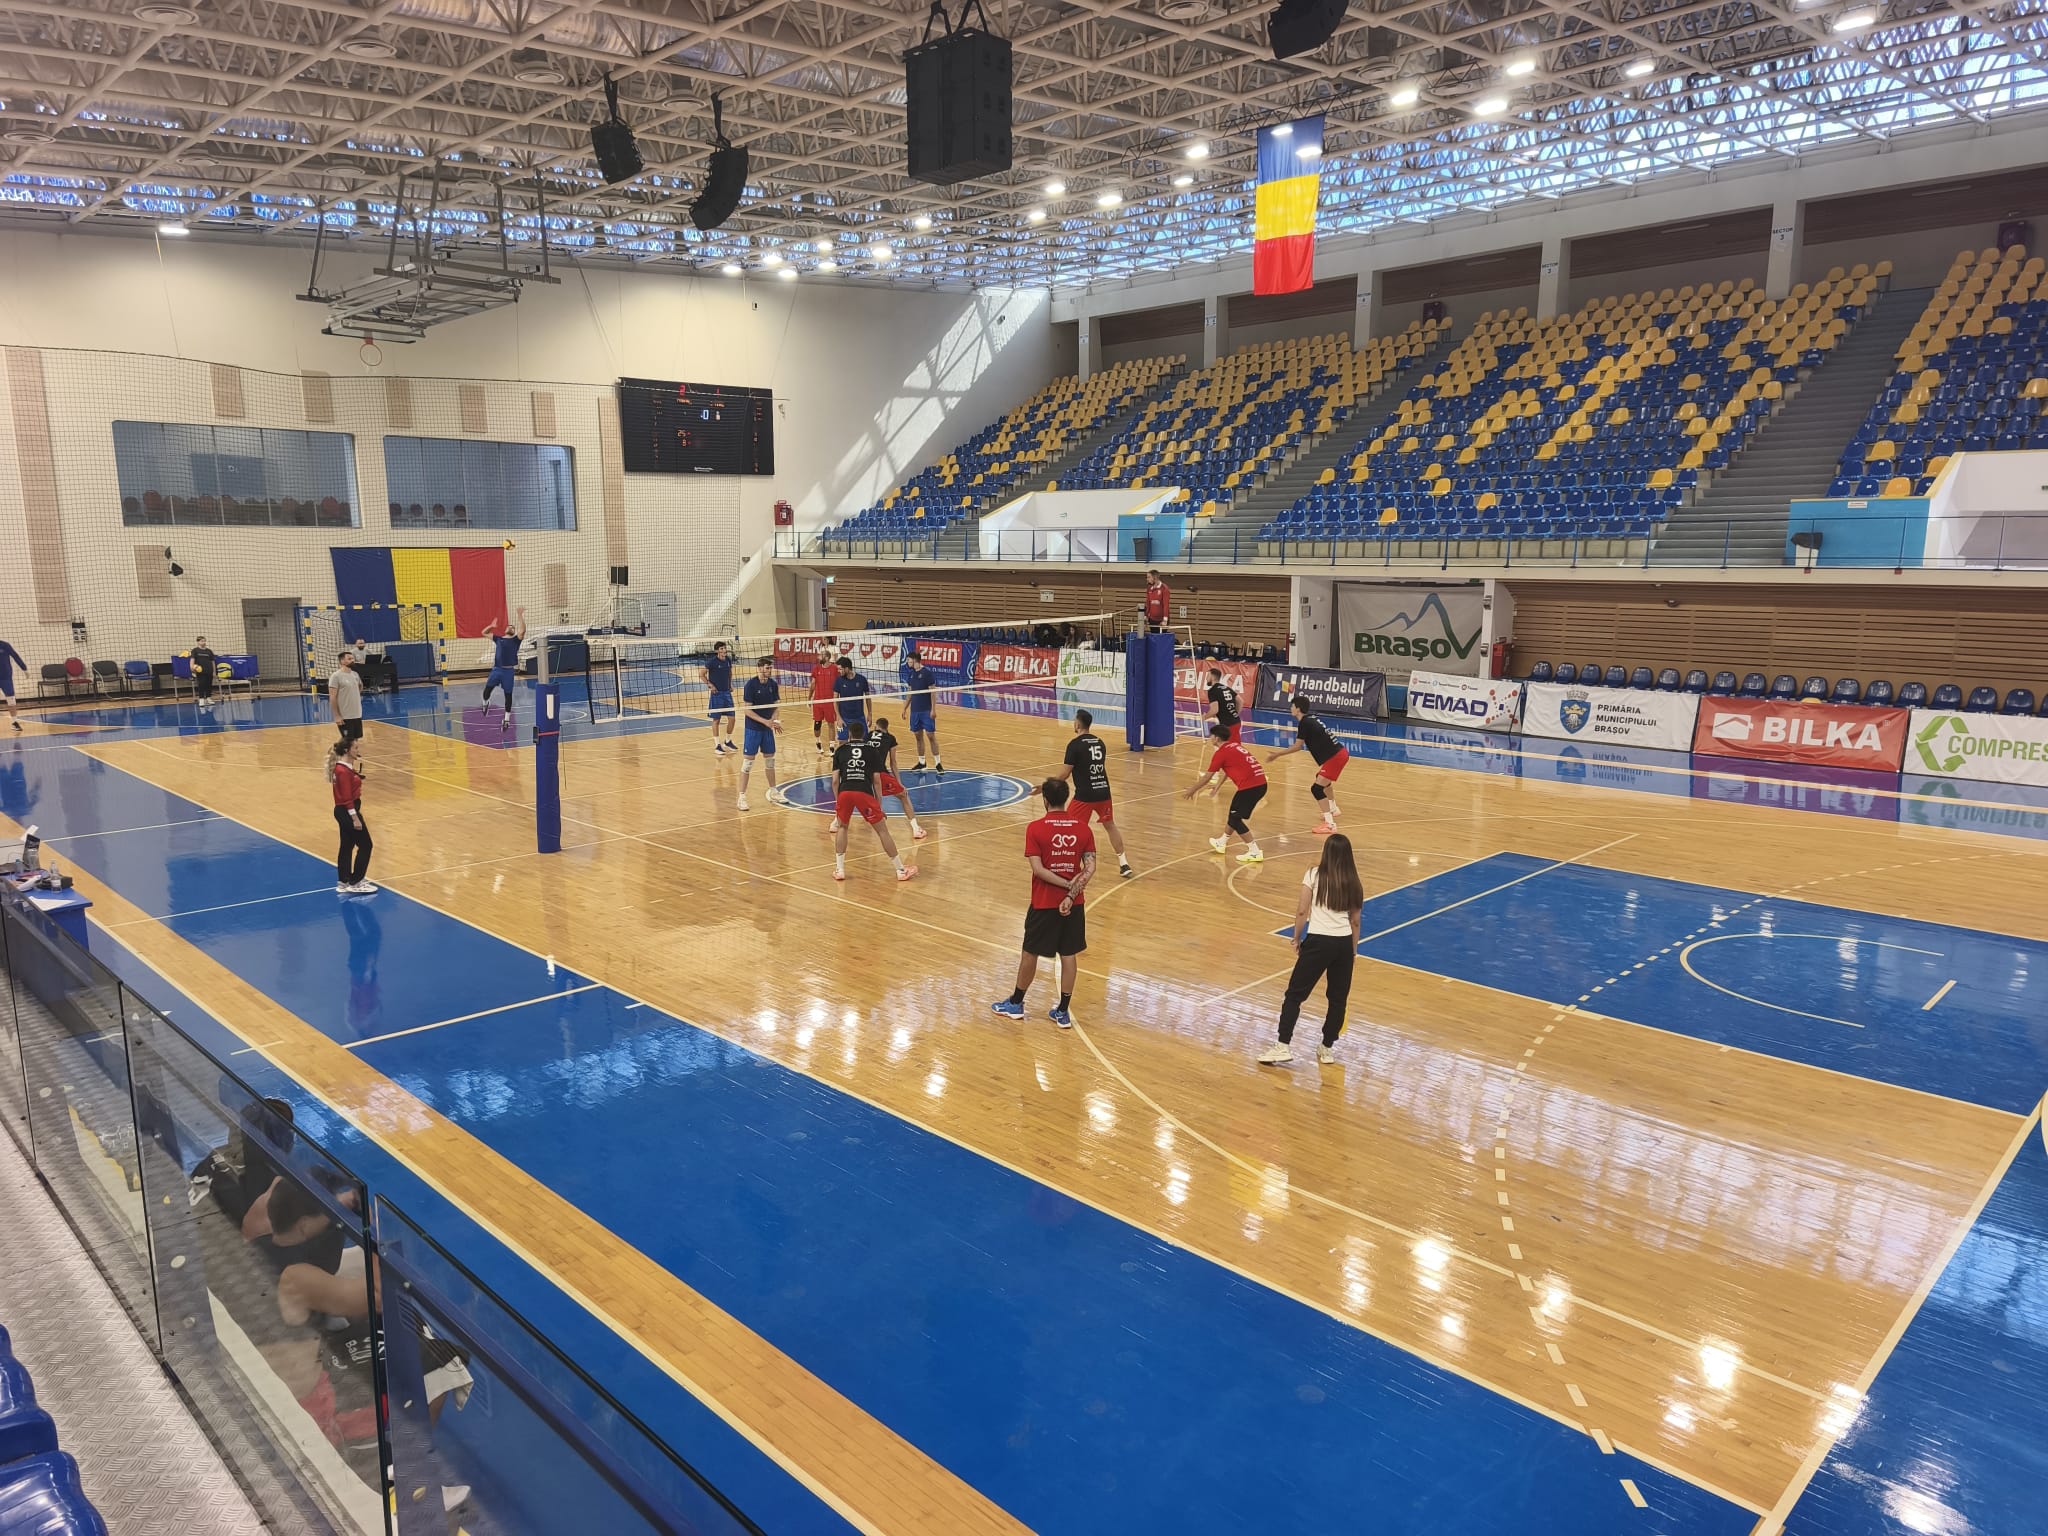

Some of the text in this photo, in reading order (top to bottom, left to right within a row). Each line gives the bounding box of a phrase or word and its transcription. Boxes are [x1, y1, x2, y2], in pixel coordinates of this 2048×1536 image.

[795, 638, 822, 654] BILK
[1004, 655, 1050, 676] BILKA
[1300, 674, 1365, 695] Handbalul
[1410, 691, 1488, 716] TEMAD
[1596, 714, 1657, 726] MUNICIPIULUI
[1762, 716, 1882, 751] BILKA
[851, 748, 863, 759] 9
[1088, 745, 1103, 760] 15
